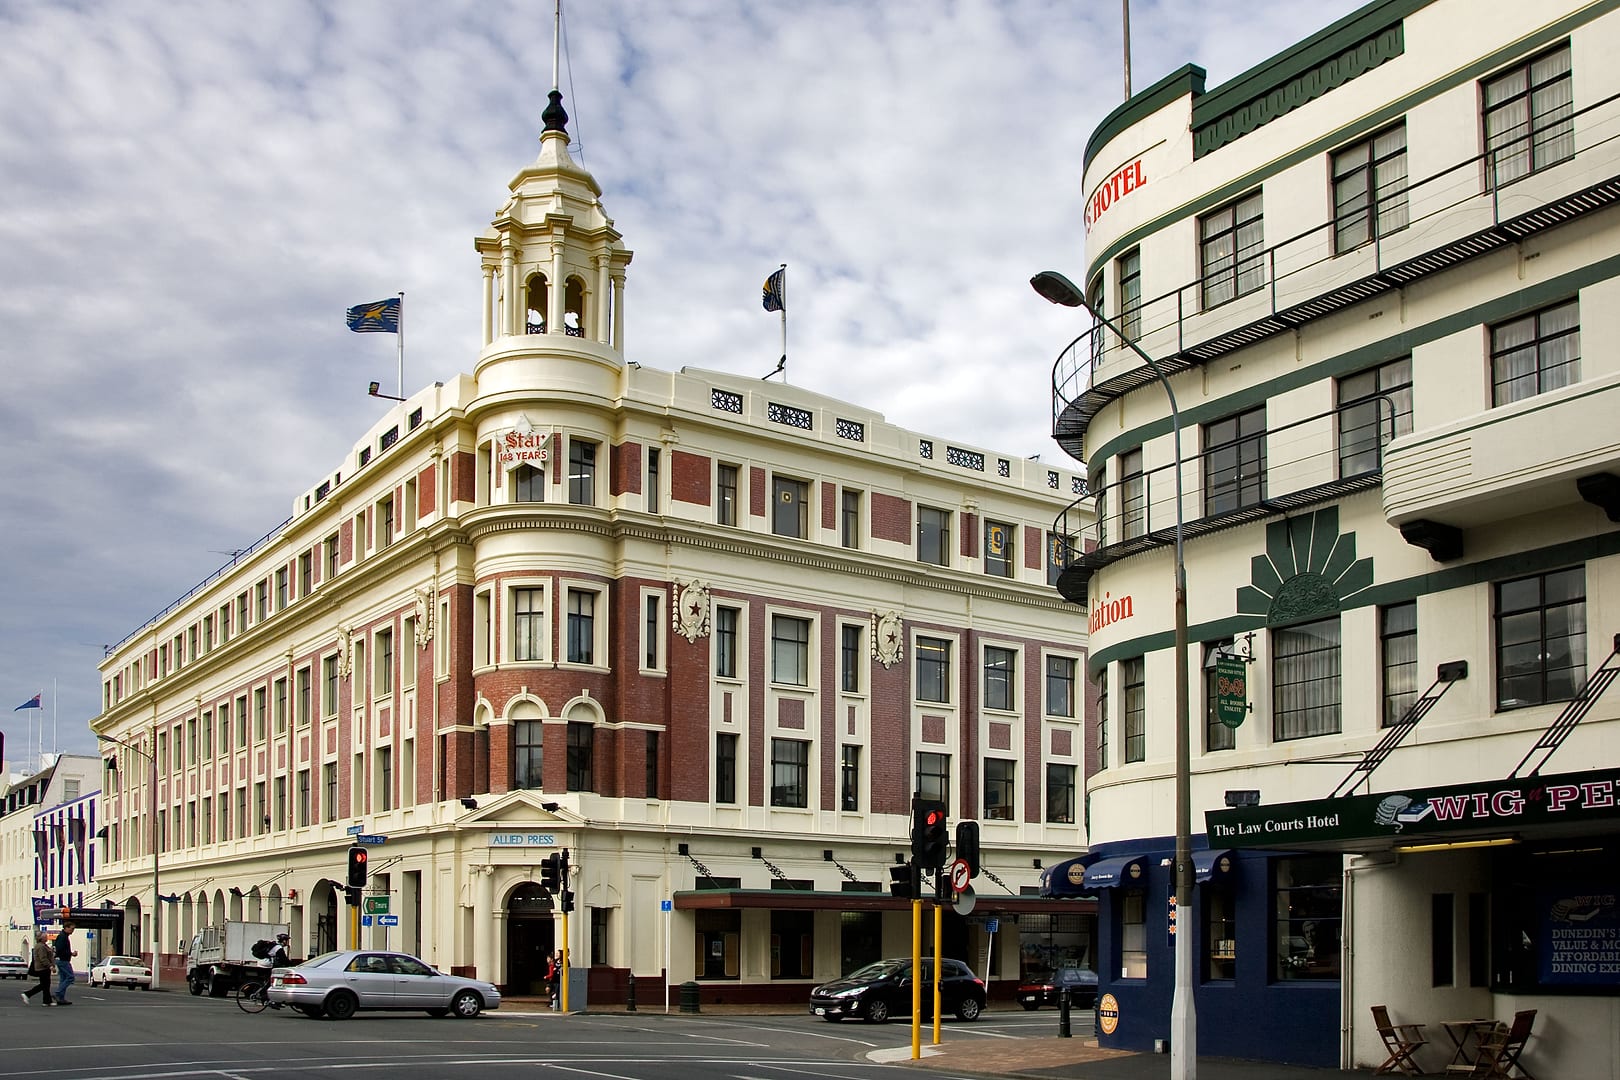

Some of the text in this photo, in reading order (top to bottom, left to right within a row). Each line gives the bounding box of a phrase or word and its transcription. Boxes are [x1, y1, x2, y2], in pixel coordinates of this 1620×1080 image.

[1093, 160, 1147, 224] HOTEL
[505, 431, 546, 449] Star
[516, 450, 547, 460] YEARS
[1427, 790, 1525, 821] WIG
[1546, 780, 1620, 812] PE
[1214, 813, 1340, 837] The Law Courts Hotel
[358, 836, 376, 844] Stuart
[493, 835, 554, 845] ALLIED PRESS
[1552, 928, 1616, 938] DUNEDIN'S
[1552, 940, 1588, 950] VALUE
[1590, 940, 1599, 950] &
[1552, 963, 1597, 973] DINING
